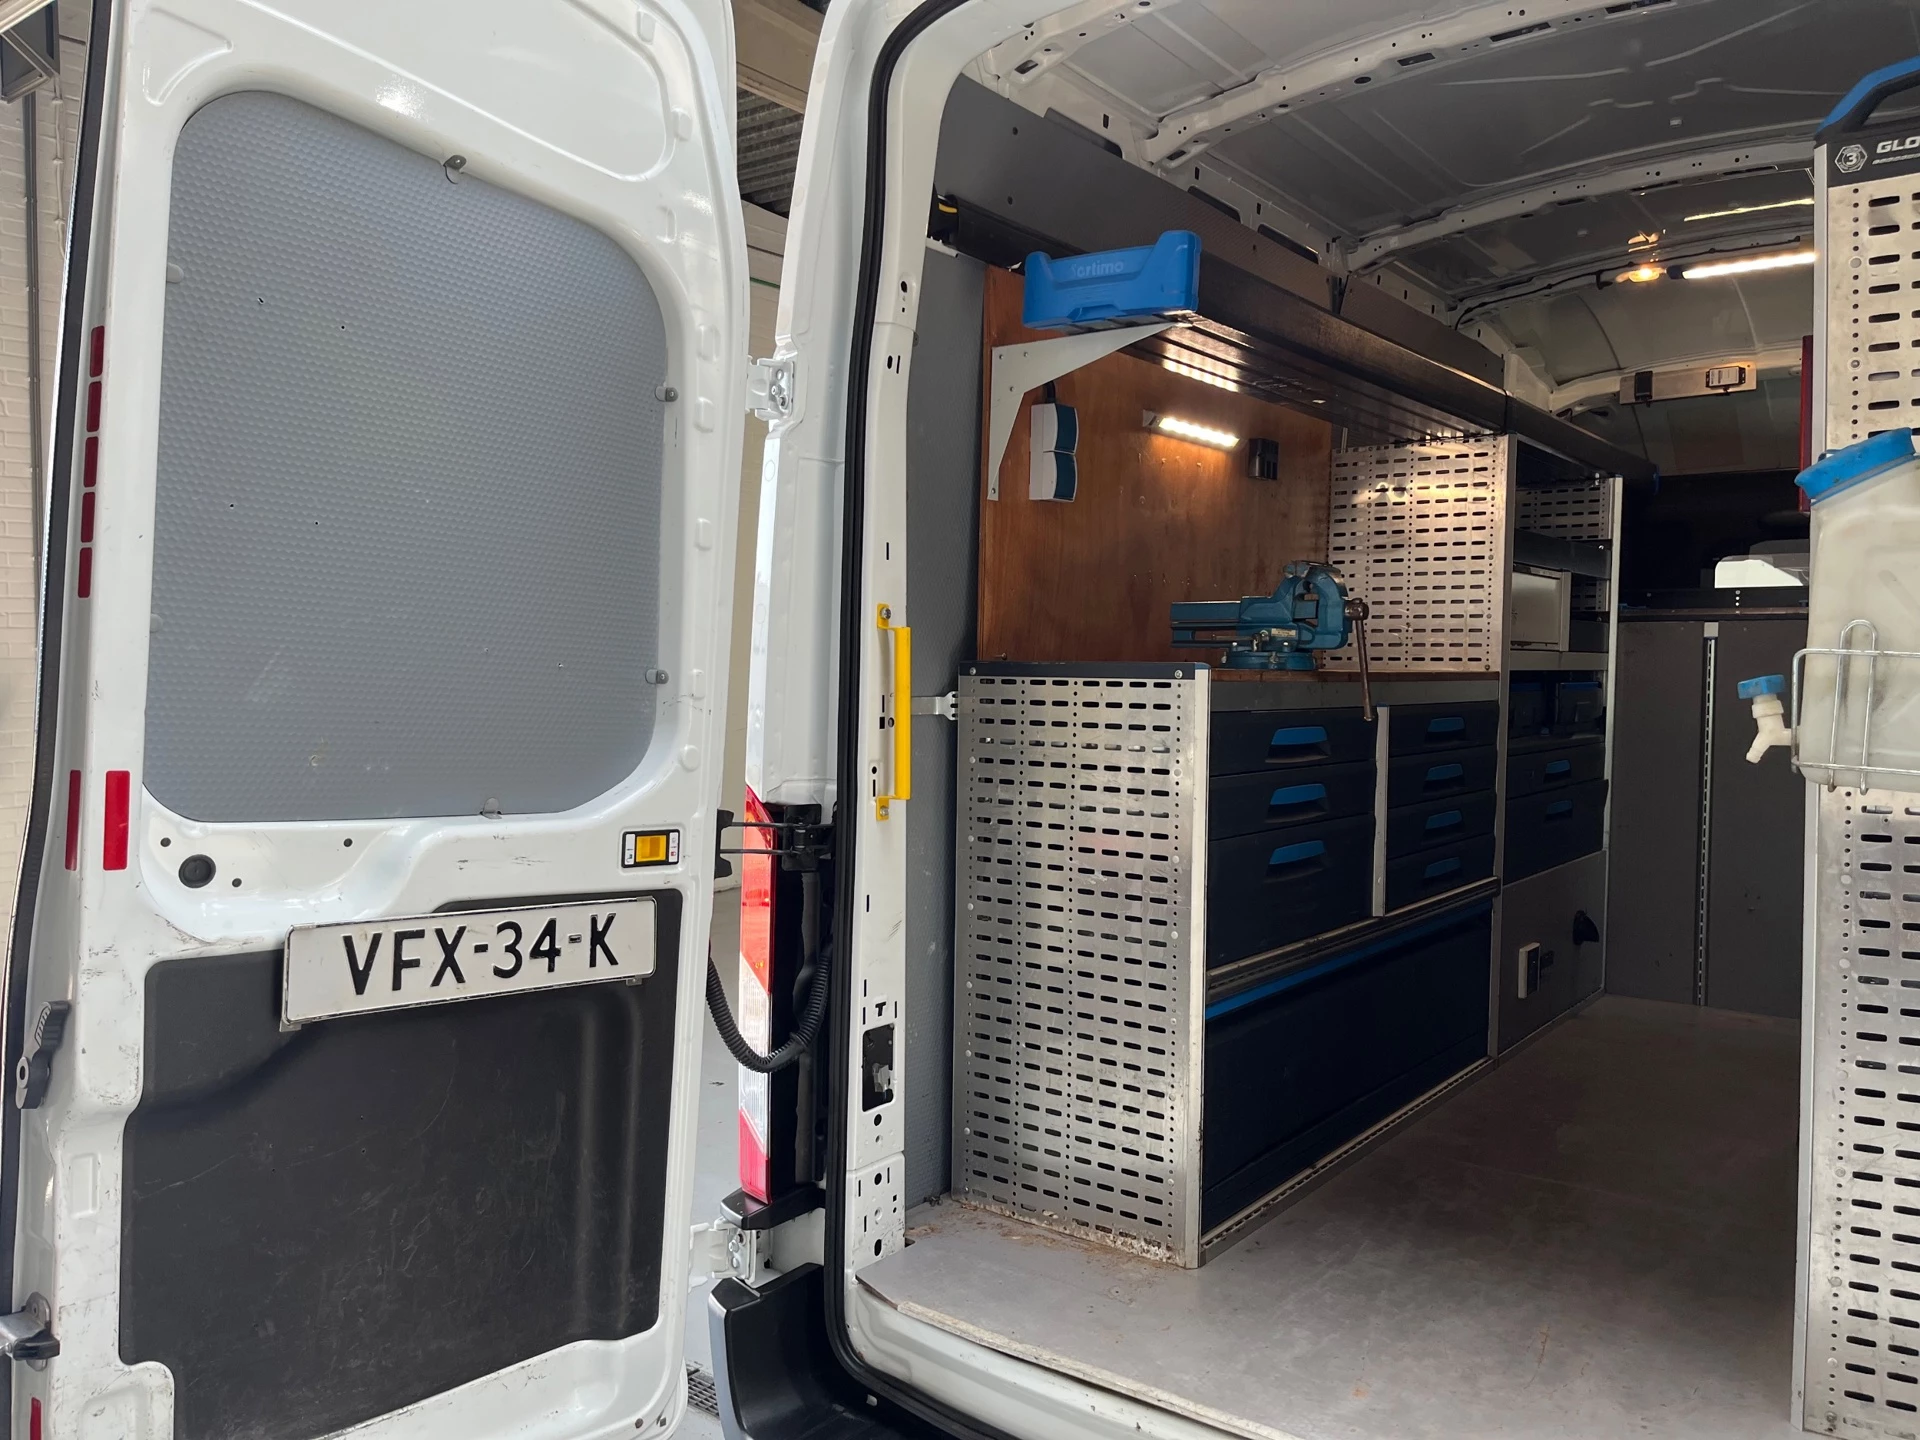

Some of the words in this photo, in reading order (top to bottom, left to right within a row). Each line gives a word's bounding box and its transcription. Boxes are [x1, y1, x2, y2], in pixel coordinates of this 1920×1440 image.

[1876, 135, 1920, 154] GLO
[1846, 152, 1858, 166] 3
[342, 912, 619, 996] VFX-34-K
